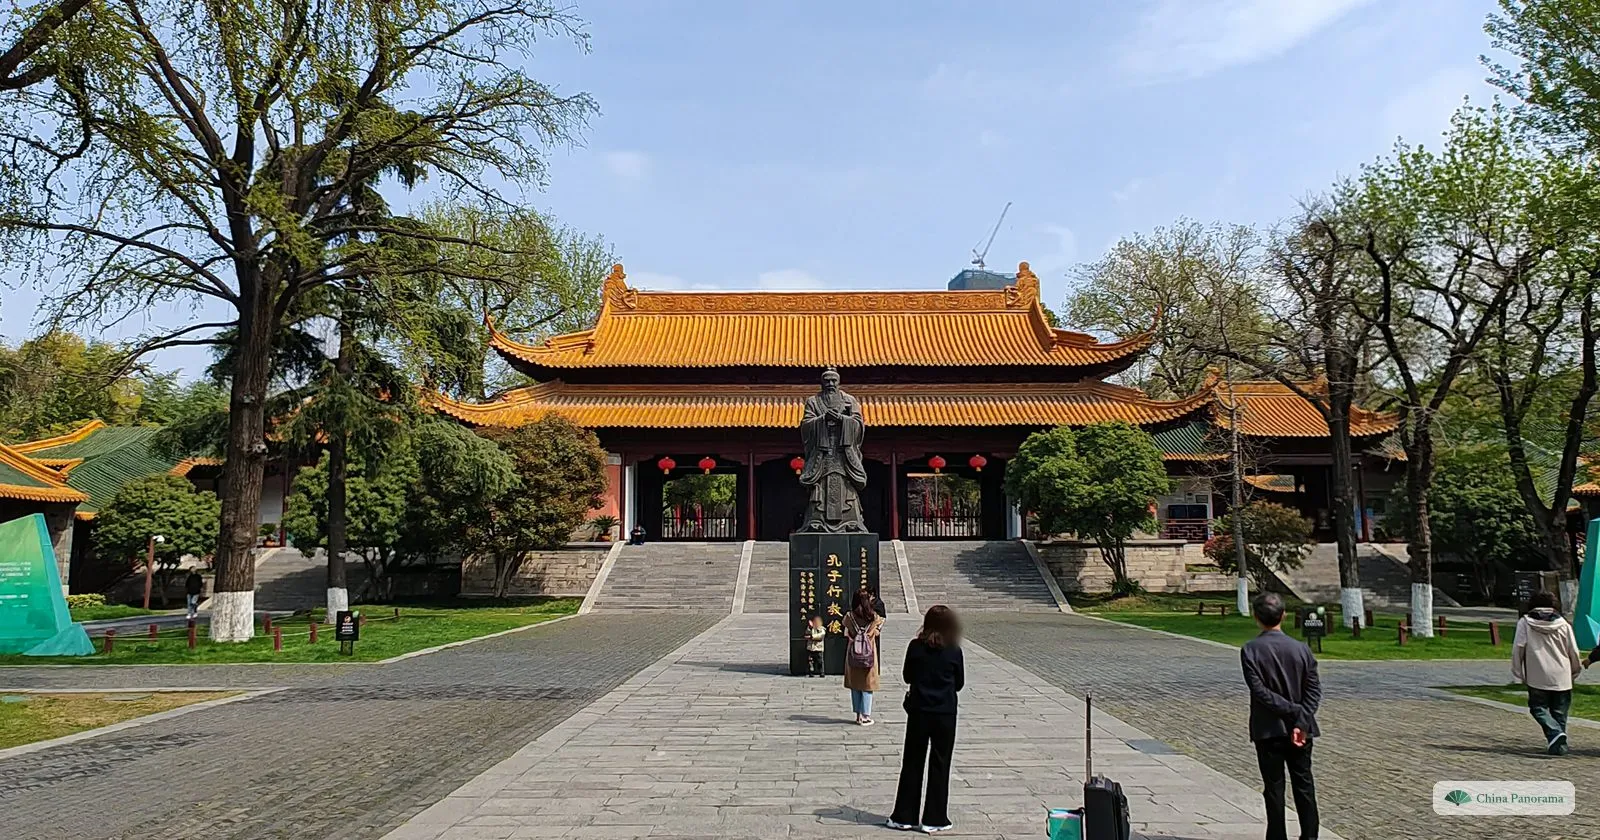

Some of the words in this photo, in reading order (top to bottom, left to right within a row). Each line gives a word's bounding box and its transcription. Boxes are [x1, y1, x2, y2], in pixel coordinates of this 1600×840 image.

[826, 554, 843, 633] 孔子行教像
